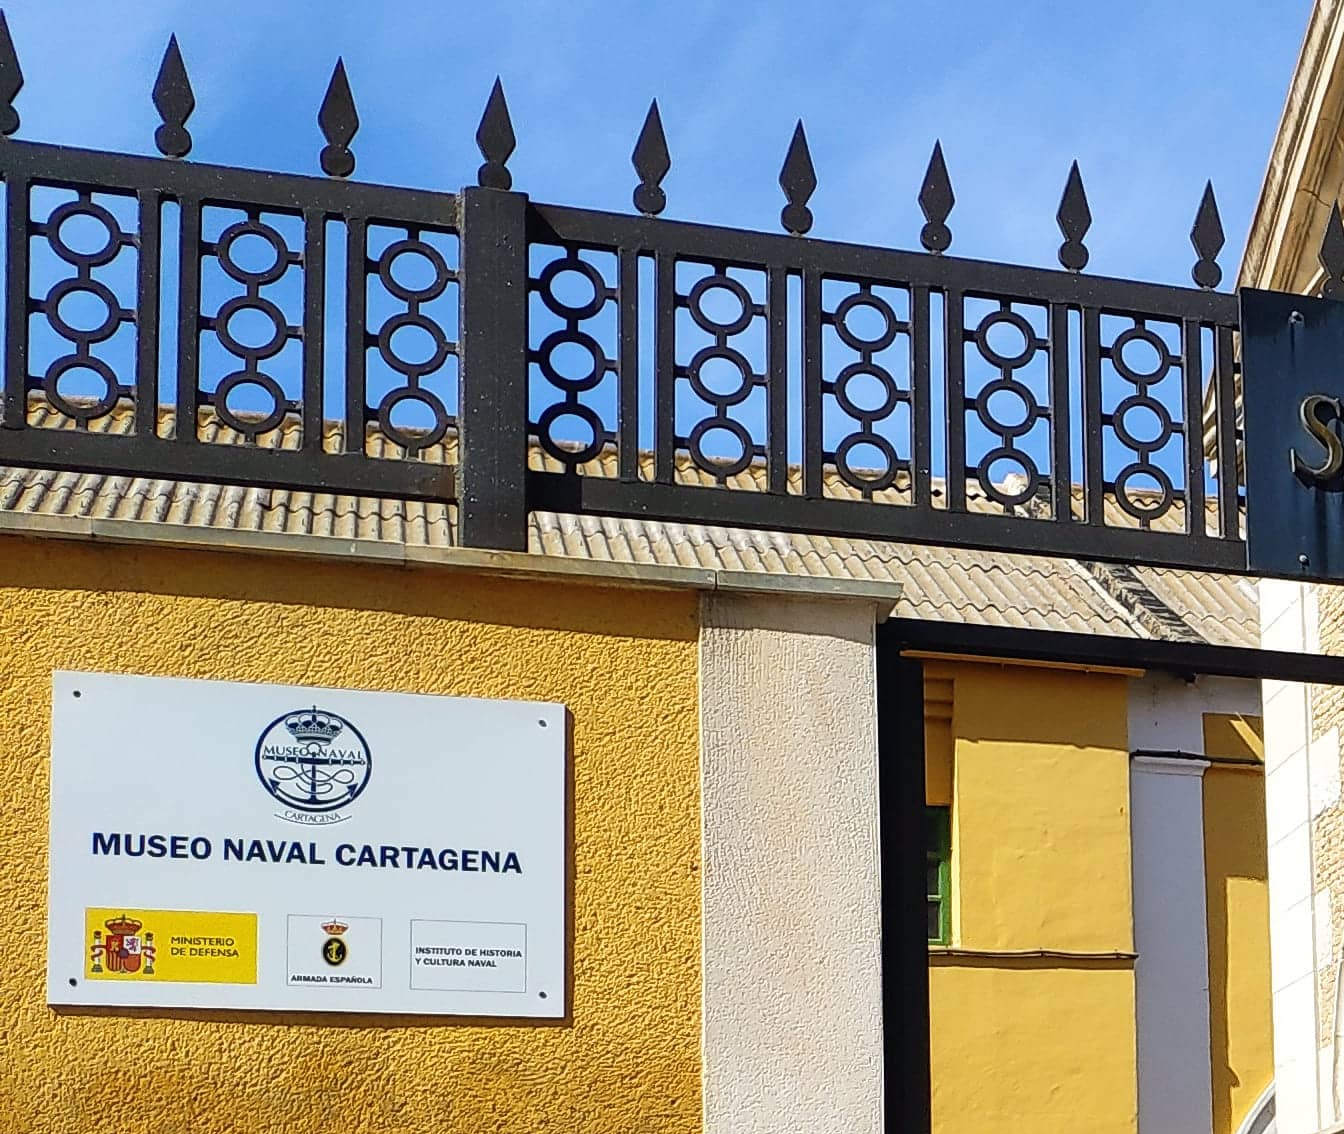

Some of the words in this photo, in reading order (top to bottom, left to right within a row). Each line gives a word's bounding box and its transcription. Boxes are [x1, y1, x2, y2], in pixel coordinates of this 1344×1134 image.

[263, 745, 309, 757] MUSEO
[318, 747, 362, 760] NAVAL
[284, 810, 341, 822] CARTAGENA
[92, 832, 212, 860] MUSEO
[223, 838, 326, 865] NAVAL
[335, 843, 523, 874] CARTAGENA
[170, 936, 235, 947] MINISTERIO
[170, 947, 186, 956] DE
[189, 948, 240, 958] DEFENSA
[415, 947, 463, 956] INSTITUTO
[464, 948, 478, 957] DE
[479, 949, 523, 958] HISTORIA
[414, 957, 421, 966] Y
[423, 957, 466, 967] CULTURA
[467, 959, 498, 968] NAVAL
[290, 974, 328, 983] ARMADA
[329, 975, 374, 985] ESPAÑOLA
